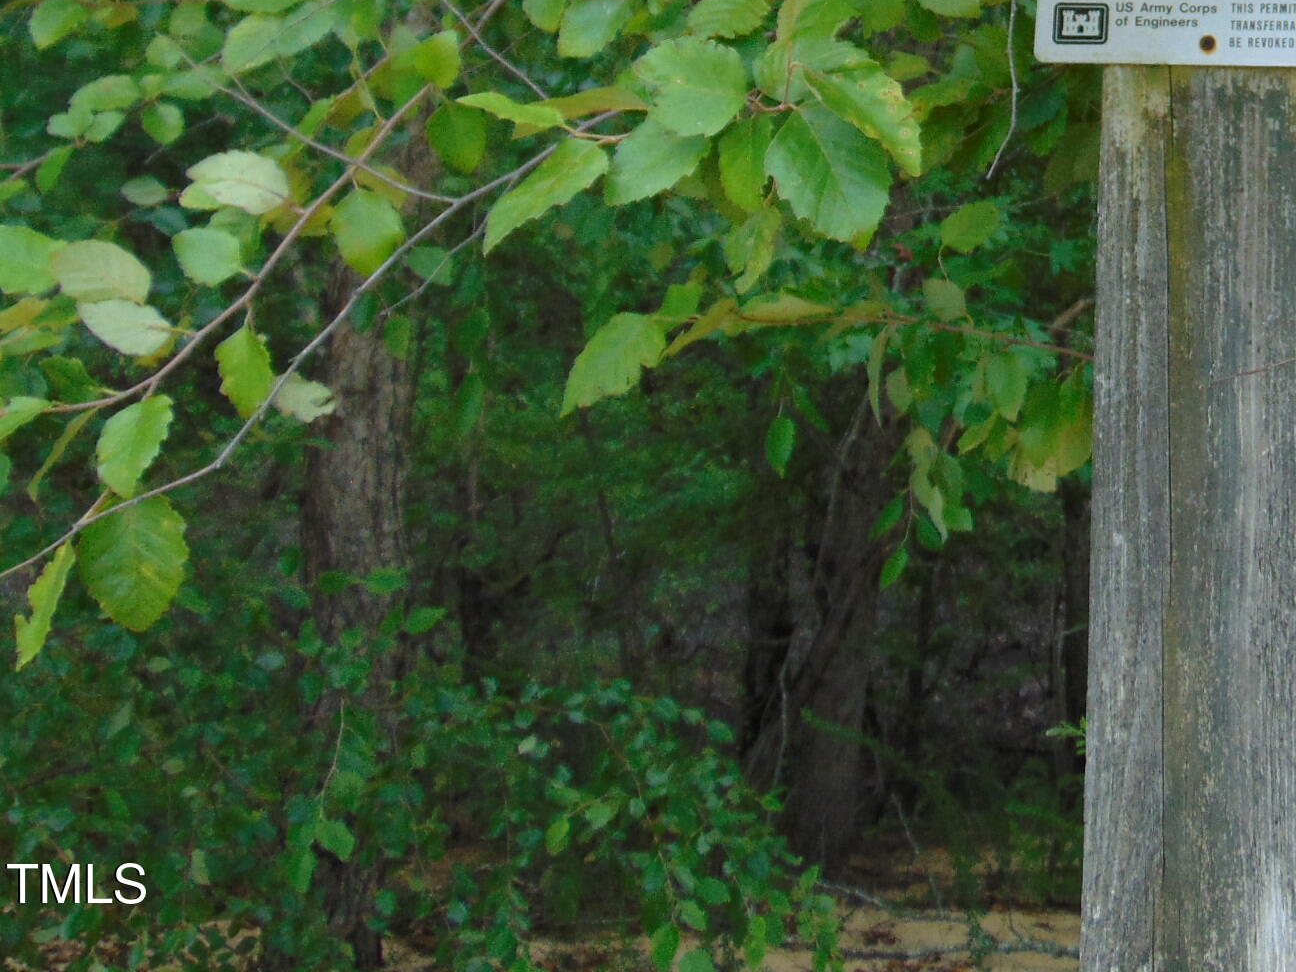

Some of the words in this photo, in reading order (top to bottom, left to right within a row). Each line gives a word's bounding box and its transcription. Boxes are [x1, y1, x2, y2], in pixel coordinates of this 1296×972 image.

[1115, 2, 1134, 13] US
[1140, 2, 1173, 15] Army
[1179, 2, 1218, 15] Corps
[1231, 3, 1254, 14] THIS
[1115, 16, 1128, 27] of
[1135, 16, 1198, 29] Engineers
[1229, 37, 1242, 48] BE
[1247, 37, 1295, 49] REVOKED
